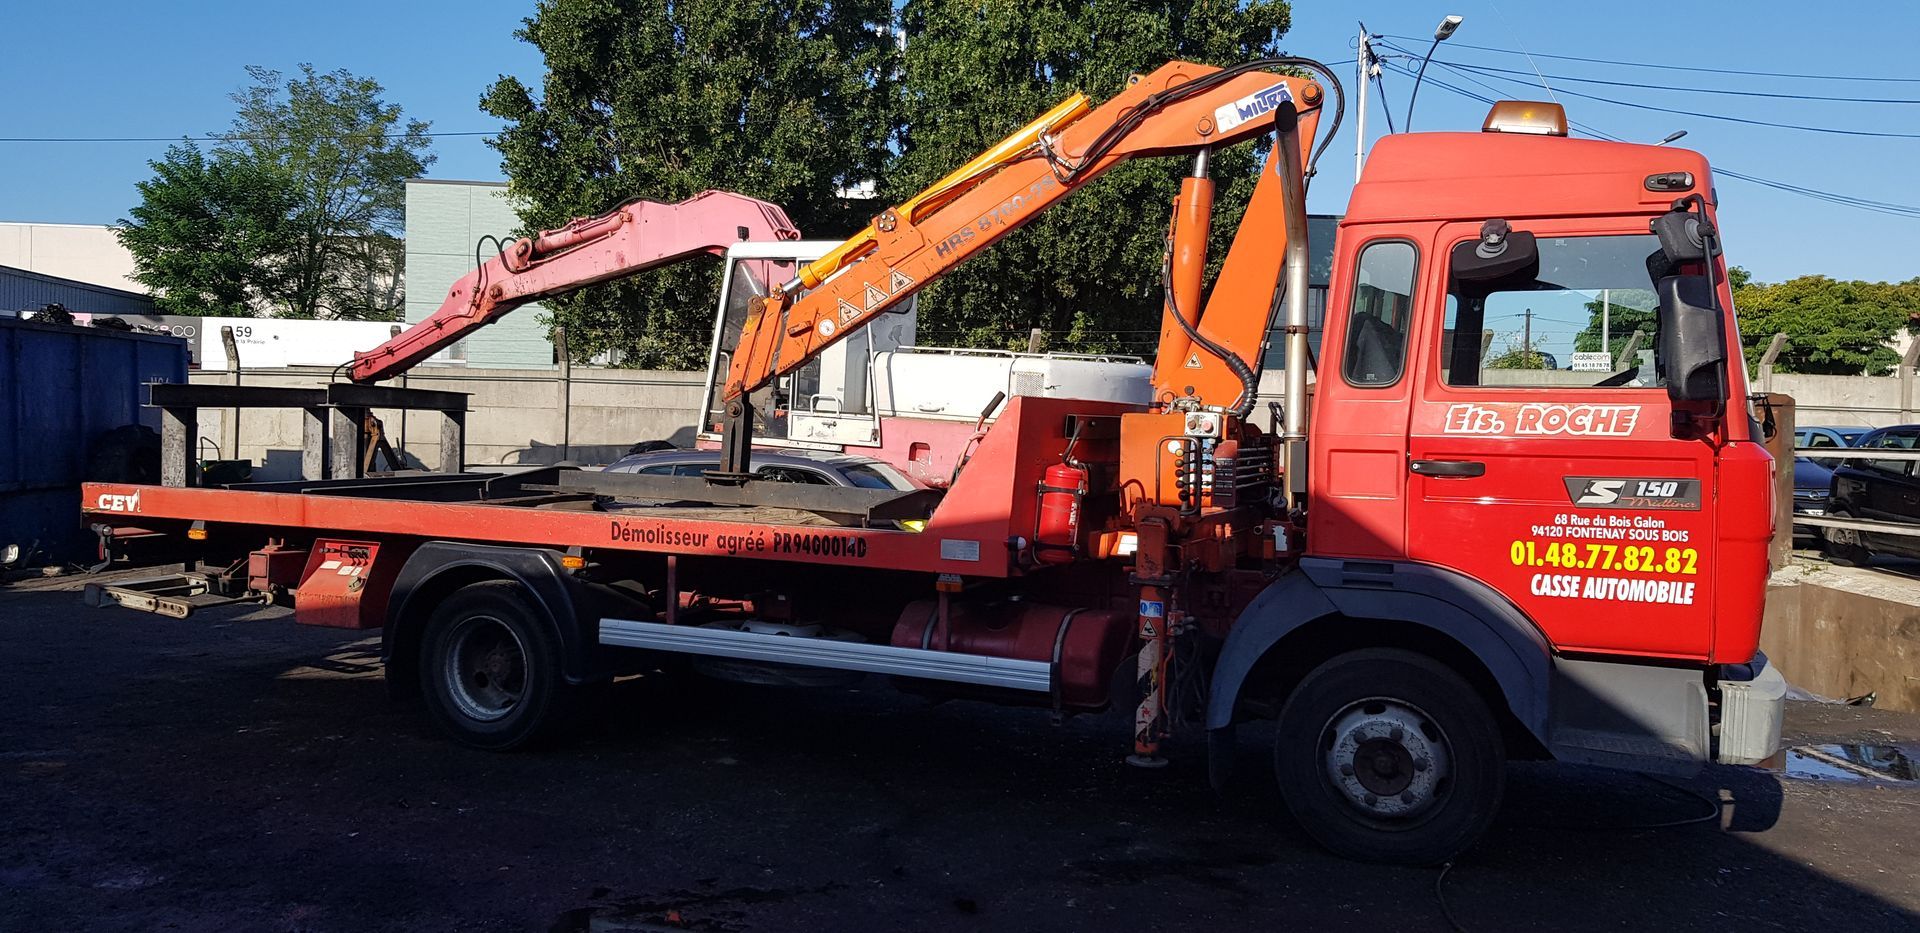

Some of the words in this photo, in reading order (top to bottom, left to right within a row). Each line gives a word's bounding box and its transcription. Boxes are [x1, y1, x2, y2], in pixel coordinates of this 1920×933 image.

[1238, 84, 1292, 120] MILTRA
[935, 226, 976, 258] HRS
[235, 326, 252, 337] 59
[1444, 404, 1505, 434] Ets.
[1515, 405, 1641, 436] ROCHE
[1636, 481, 1679, 497] 150
[1531, 526, 1563, 537] 94120
[1566, 528, 1626, 540] FONTENAY
[1629, 530, 1660, 541] SOUS
[1662, 530, 1689, 542] BOIS
[1554, 514, 1568, 525] 68
[1570, 515, 1590, 526] Rue
[1593, 515, 1607, 527] du
[1609, 516, 1631, 528] Bois
[1633, 516, 1665, 528] Galon
[611, 521, 709, 548] Démolisseur
[717, 531, 765, 556] agréé
[1510, 541, 1698, 574] 01.48.77.82.82
[1531, 574, 1581, 598] CASSE
[1583, 577, 1695, 605] AUTOMOBILE
